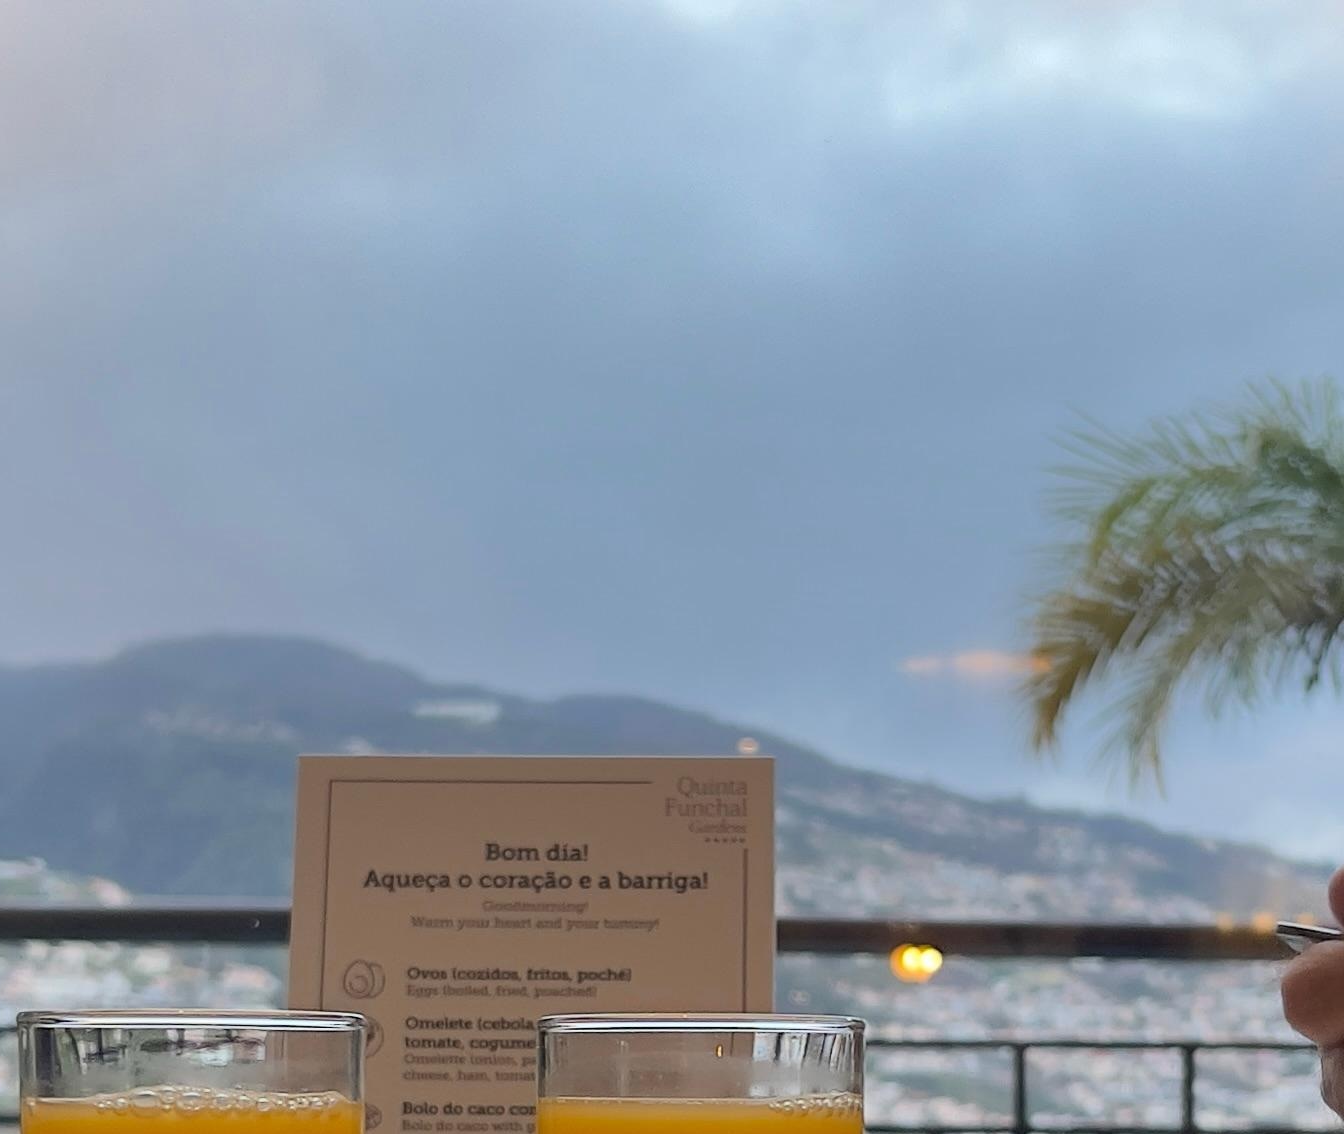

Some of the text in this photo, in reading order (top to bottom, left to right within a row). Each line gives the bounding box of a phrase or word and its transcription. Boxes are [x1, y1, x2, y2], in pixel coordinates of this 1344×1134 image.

[677, 776, 748, 798] Quinta
[665, 797, 748, 817] Funchal
[484, 843, 589, 862] Bom dia!
[363, 870, 709, 893] Aqueça o coração e a barriga!
[406, 967, 448, 981] Ovos
[526, 968, 572, 982] fritos,
[405, 1016, 473, 1031] Omelete
[404, 1036, 465, 1050] tomate,
[401, 1101, 439, 1116] Bolo
[442, 1101, 464, 1116] do
[468, 1104, 505, 1116] caco
